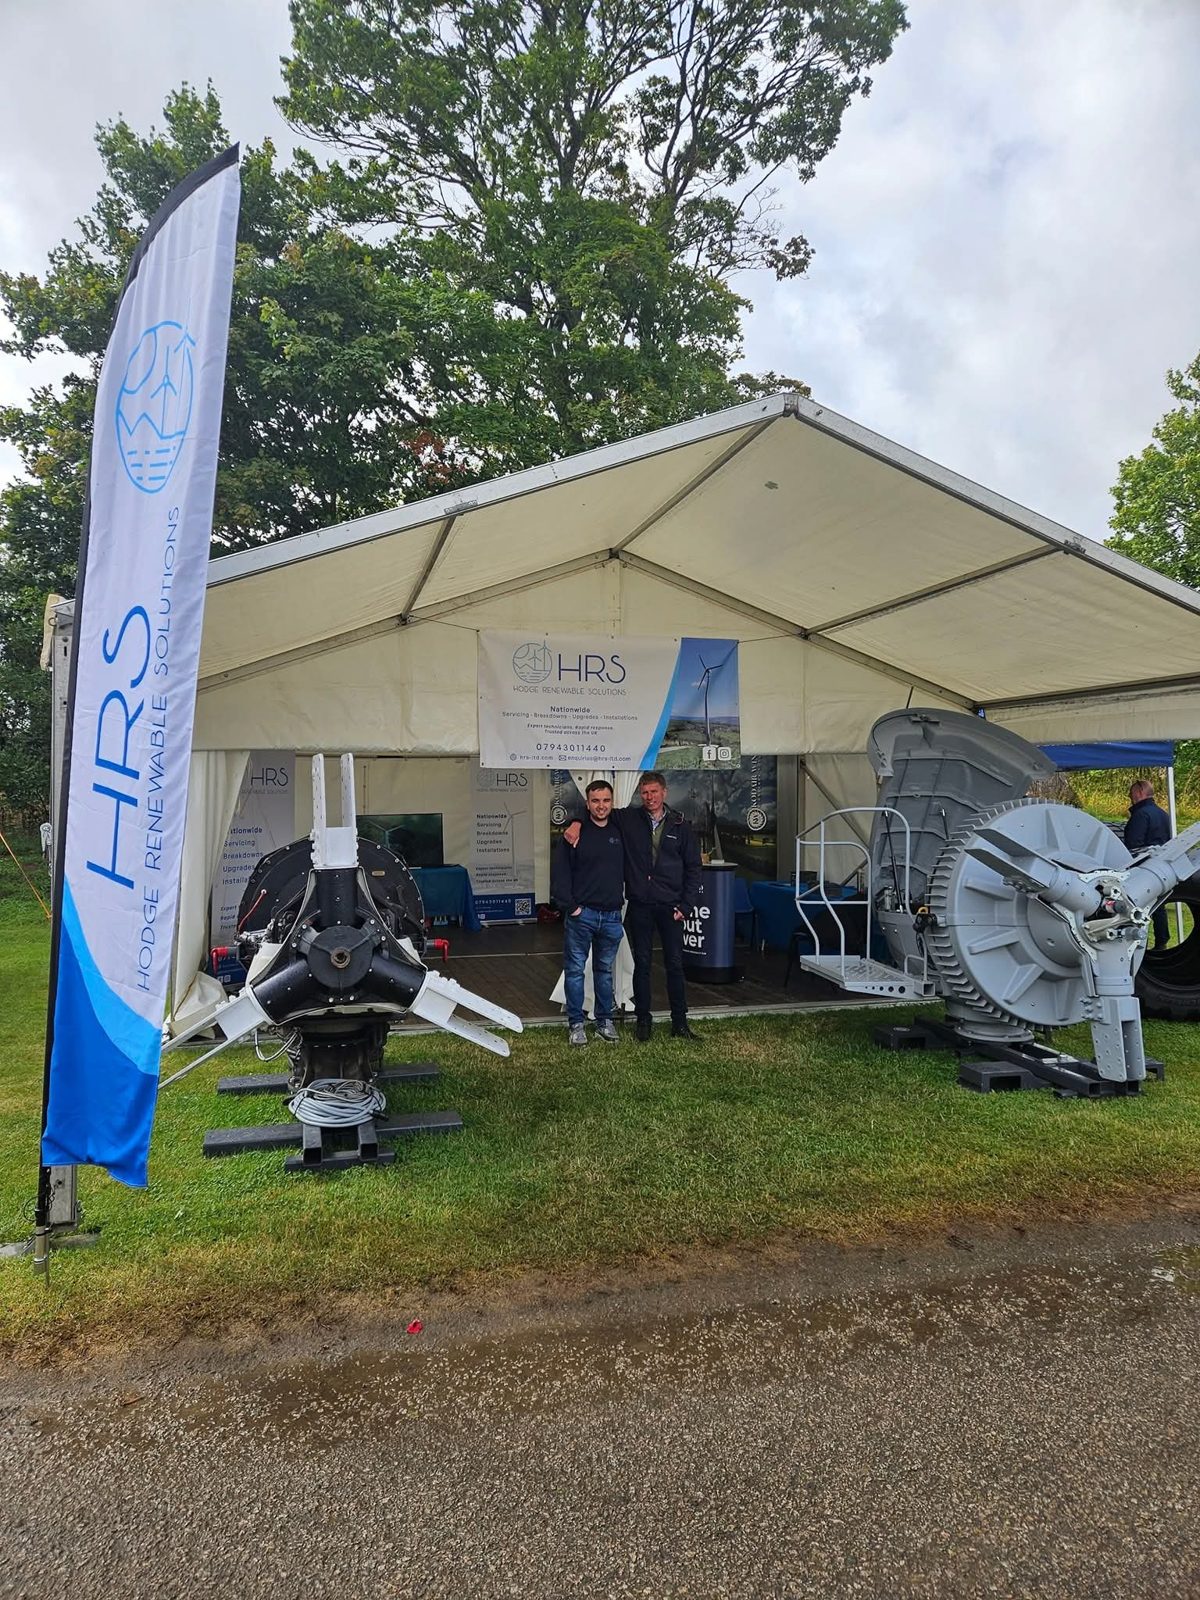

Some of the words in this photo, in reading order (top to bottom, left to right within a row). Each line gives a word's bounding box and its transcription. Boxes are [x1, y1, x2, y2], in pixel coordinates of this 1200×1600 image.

[153, 506, 180, 676] SOLUTIONS
[558, 653, 626, 684] HRS
[513, 685, 539, 694] HODGE
[542, 686, 585, 696] RENEWABLE
[588, 687, 627, 696] SOLUTIONS
[550, 705, 591, 714] Nationwide
[502, 711, 530, 719] Servicing
[534, 712, 567, 720] Breakdowns
[572, 713, 599, 721] Upgrades
[86, 605, 151, 890] HRS
[536, 743, 606, 752] 07943011440
[144, 694, 168, 871] RENEWABLE
[250, 767, 289, 787] HRS
[496, 773, 528, 787] HRS
[230, 826, 263, 834] tionwide
[224, 840, 256, 848] Servicing
[222, 876, 249, 885] Installa
[137, 885, 159, 991] HODGE
